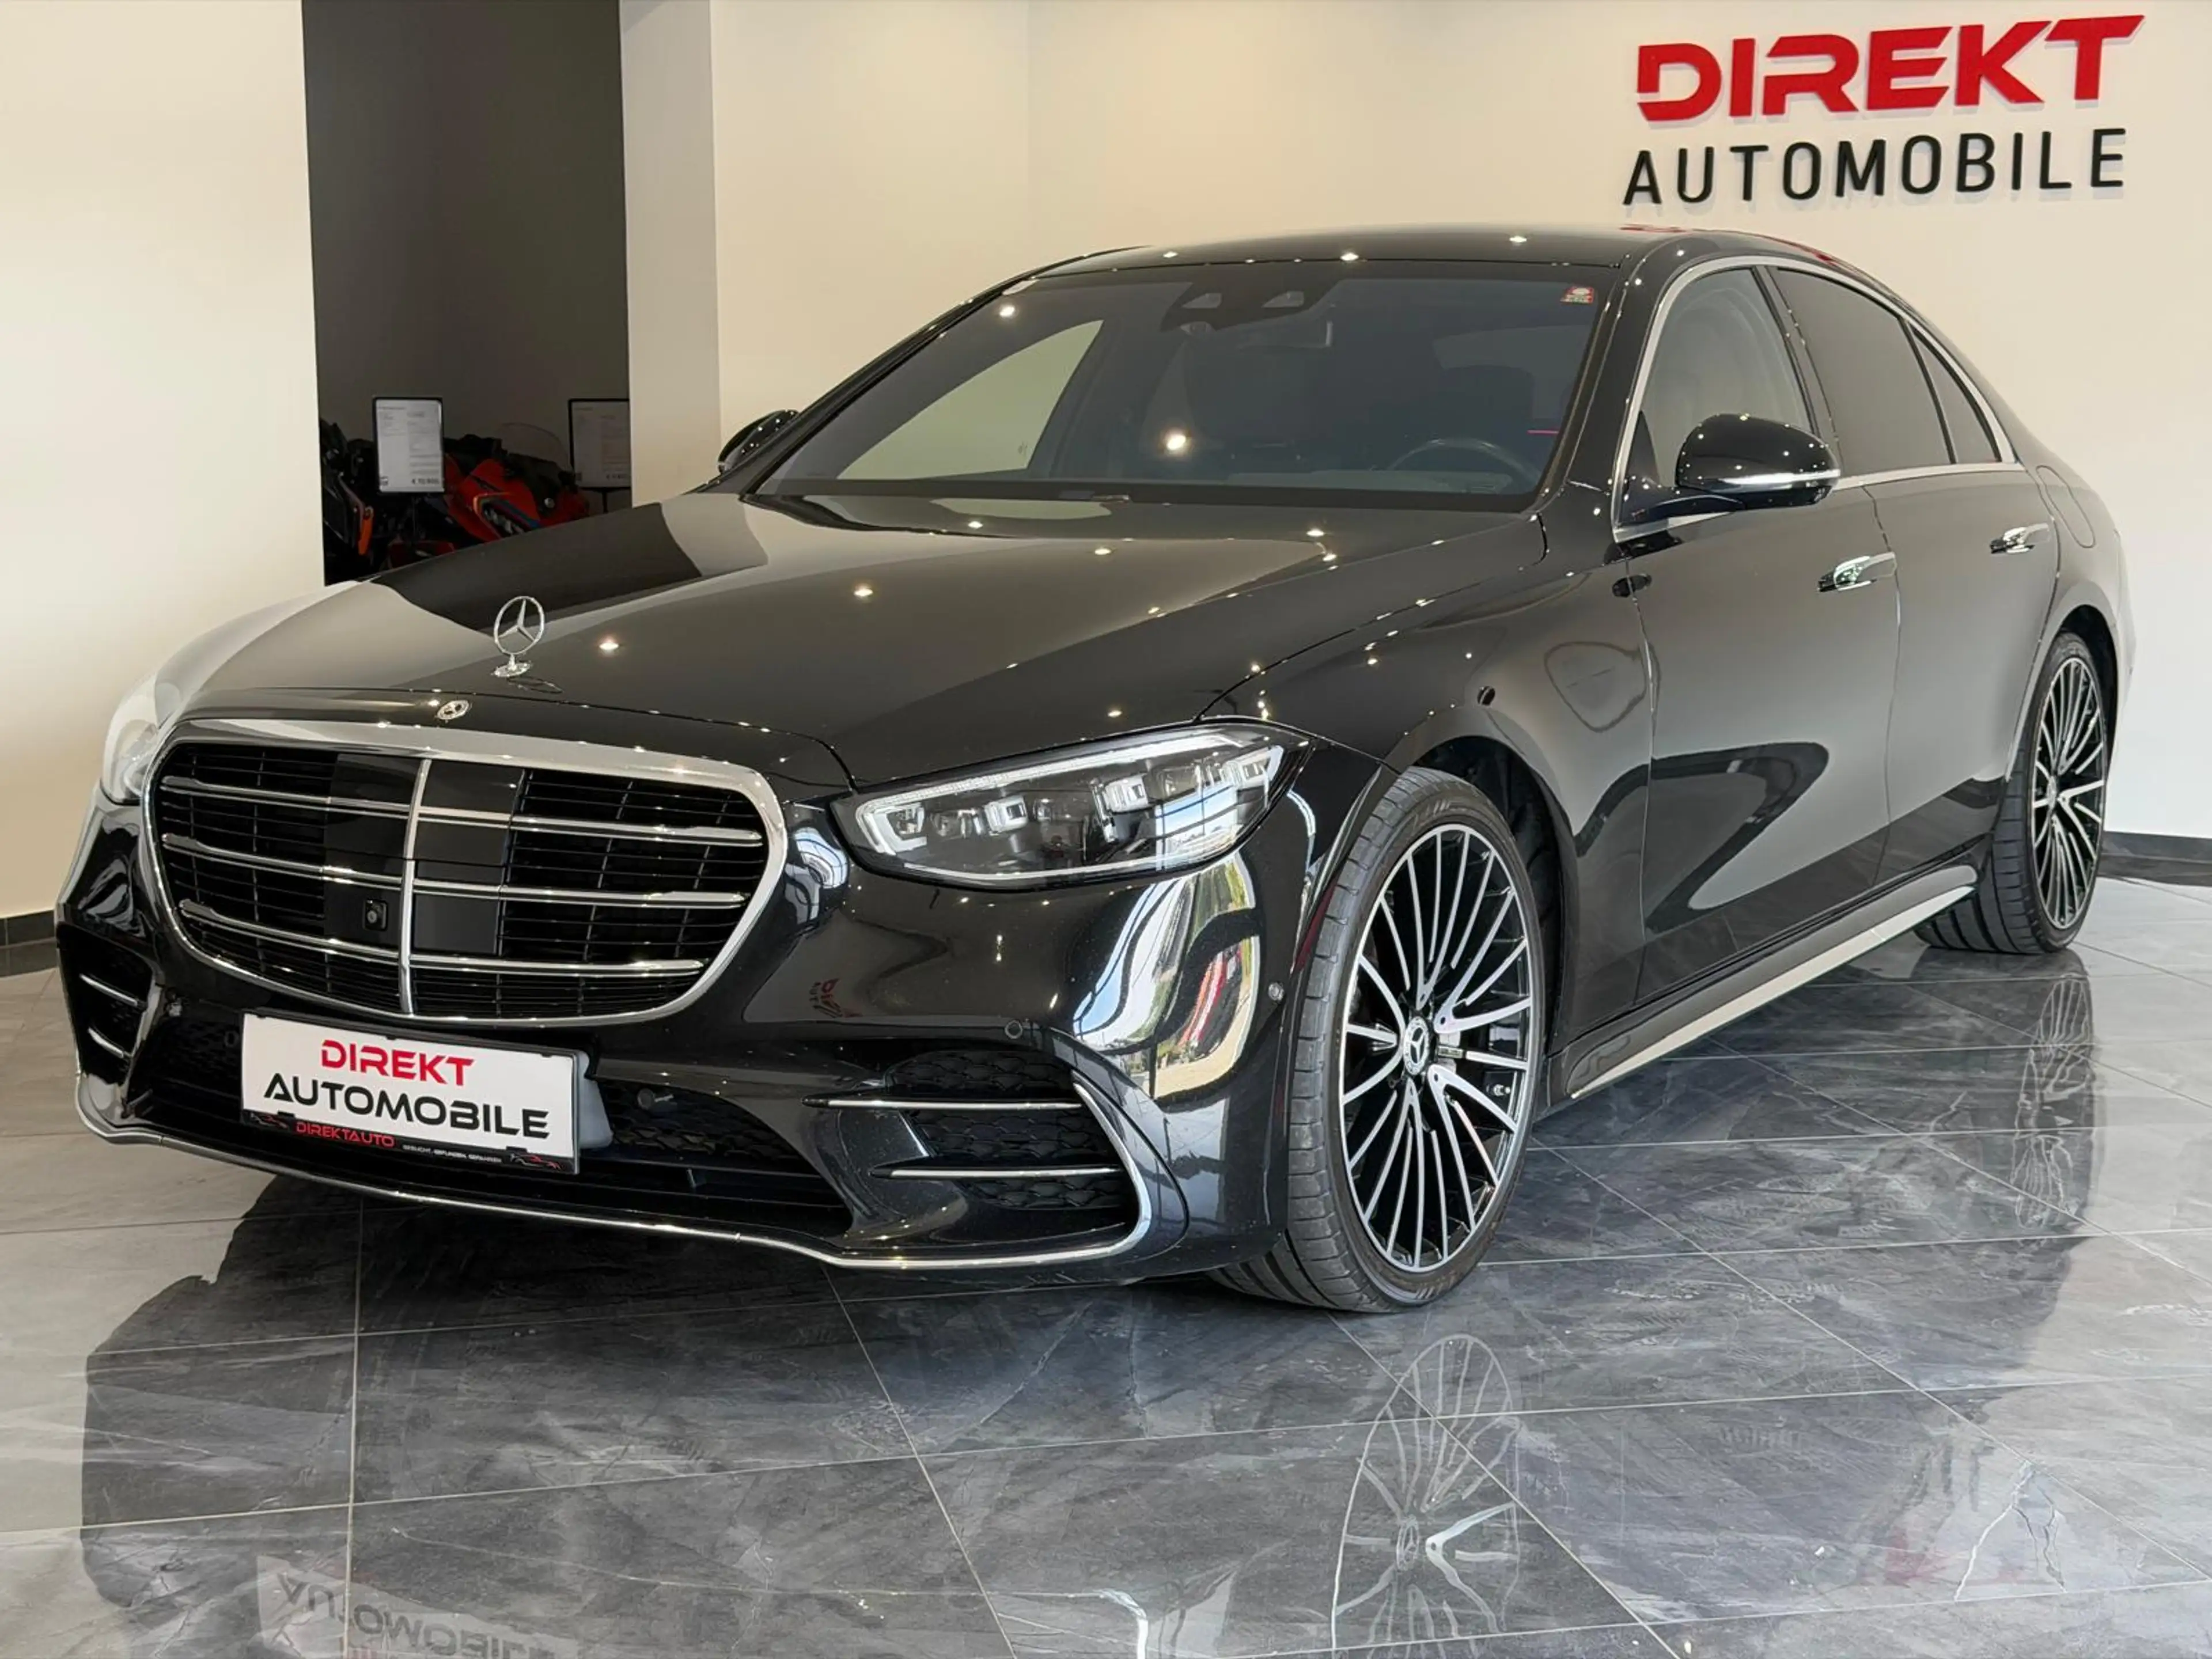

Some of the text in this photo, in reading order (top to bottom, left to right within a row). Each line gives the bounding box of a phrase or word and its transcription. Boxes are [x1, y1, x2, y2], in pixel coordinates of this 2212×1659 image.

[1637, 14, 2145, 123] DIREKT
[1623, 128, 2126, 205] AUTOMOBILE
[320, 1039, 474, 1086] DIREKT
[263, 1073, 550, 1139] AUTOMOBILE
[296, 1122, 395, 1147] DIREKTAUTO
